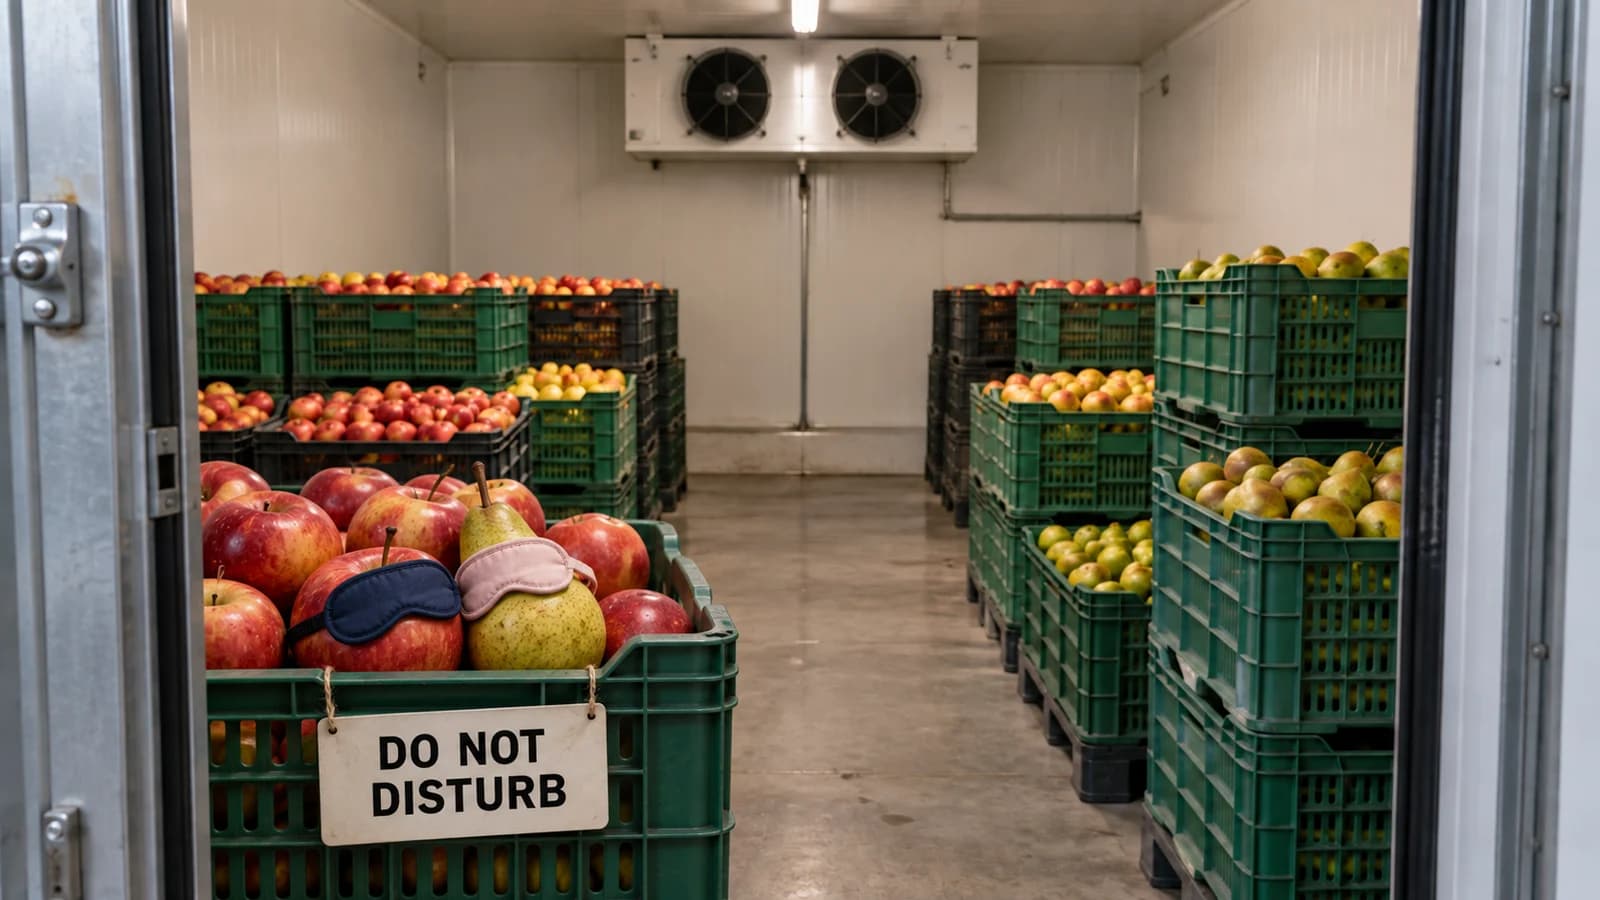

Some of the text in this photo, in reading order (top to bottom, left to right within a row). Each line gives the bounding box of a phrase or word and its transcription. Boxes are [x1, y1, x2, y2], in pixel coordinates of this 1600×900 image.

[379, 728, 545, 770] DO NOT
[372, 773, 567, 817] DISTURB
